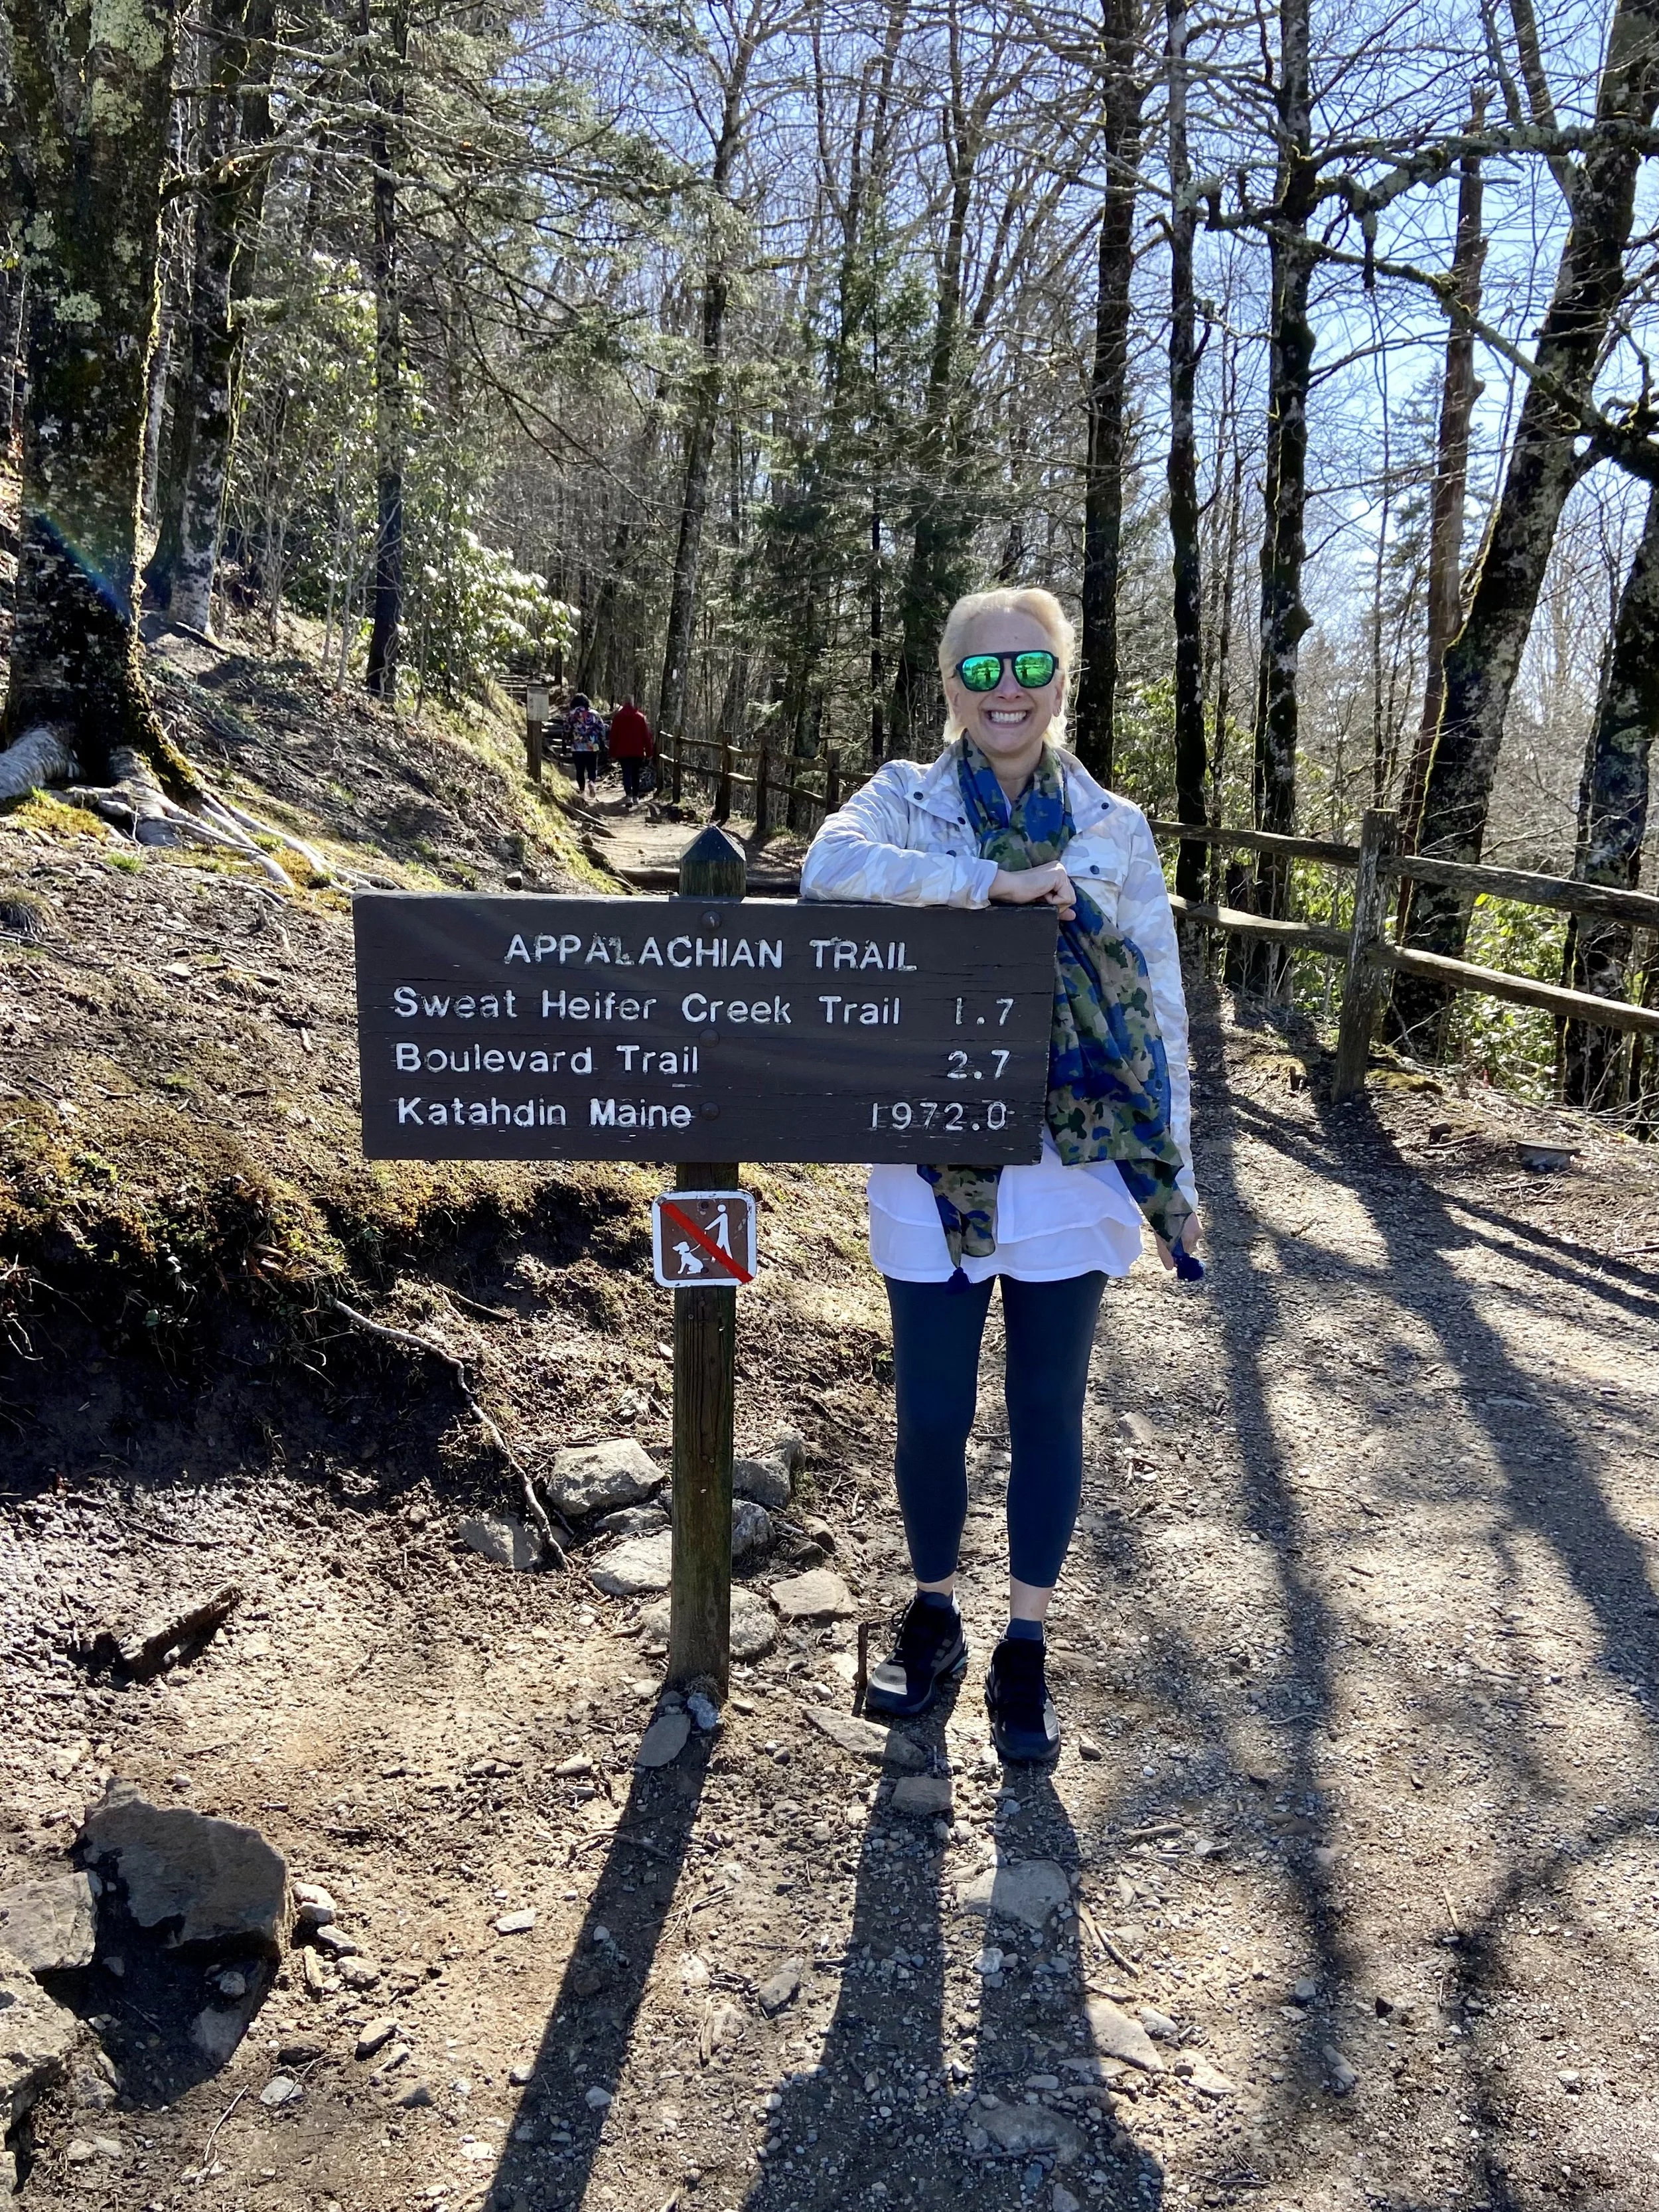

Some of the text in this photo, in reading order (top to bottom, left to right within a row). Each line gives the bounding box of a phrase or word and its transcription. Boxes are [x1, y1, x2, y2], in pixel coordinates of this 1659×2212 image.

[505, 934, 917, 972] APPALACHIAN TRAIL
[394, 986, 1014, 1025] Sweat Heifer Creek Trail 1.7
[396, 1043, 1010, 1080] Boulevard Trail 2.7
[398, 1096, 1007, 1131] Katahdin Maine 1972.0
